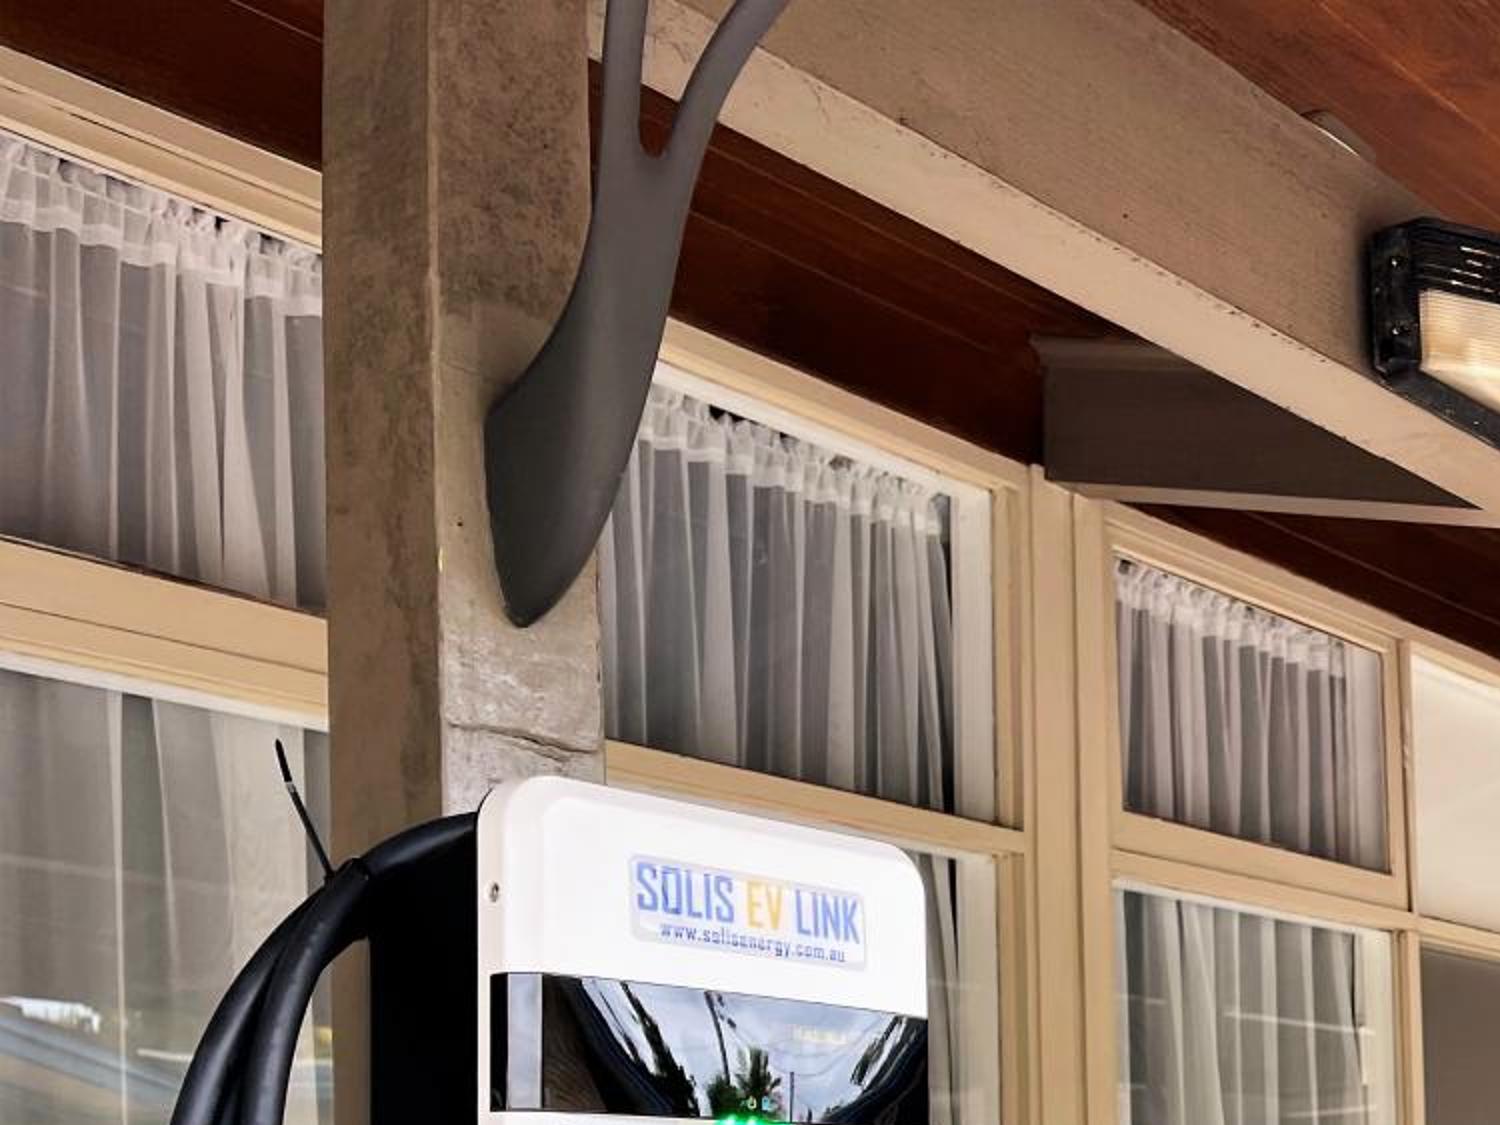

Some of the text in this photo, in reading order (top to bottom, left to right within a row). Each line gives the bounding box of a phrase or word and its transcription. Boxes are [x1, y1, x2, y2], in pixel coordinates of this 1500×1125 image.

[636, 861, 861, 944] SOLIS EV LINK
[658, 923, 846, 963] www.solisenergy.com.au
